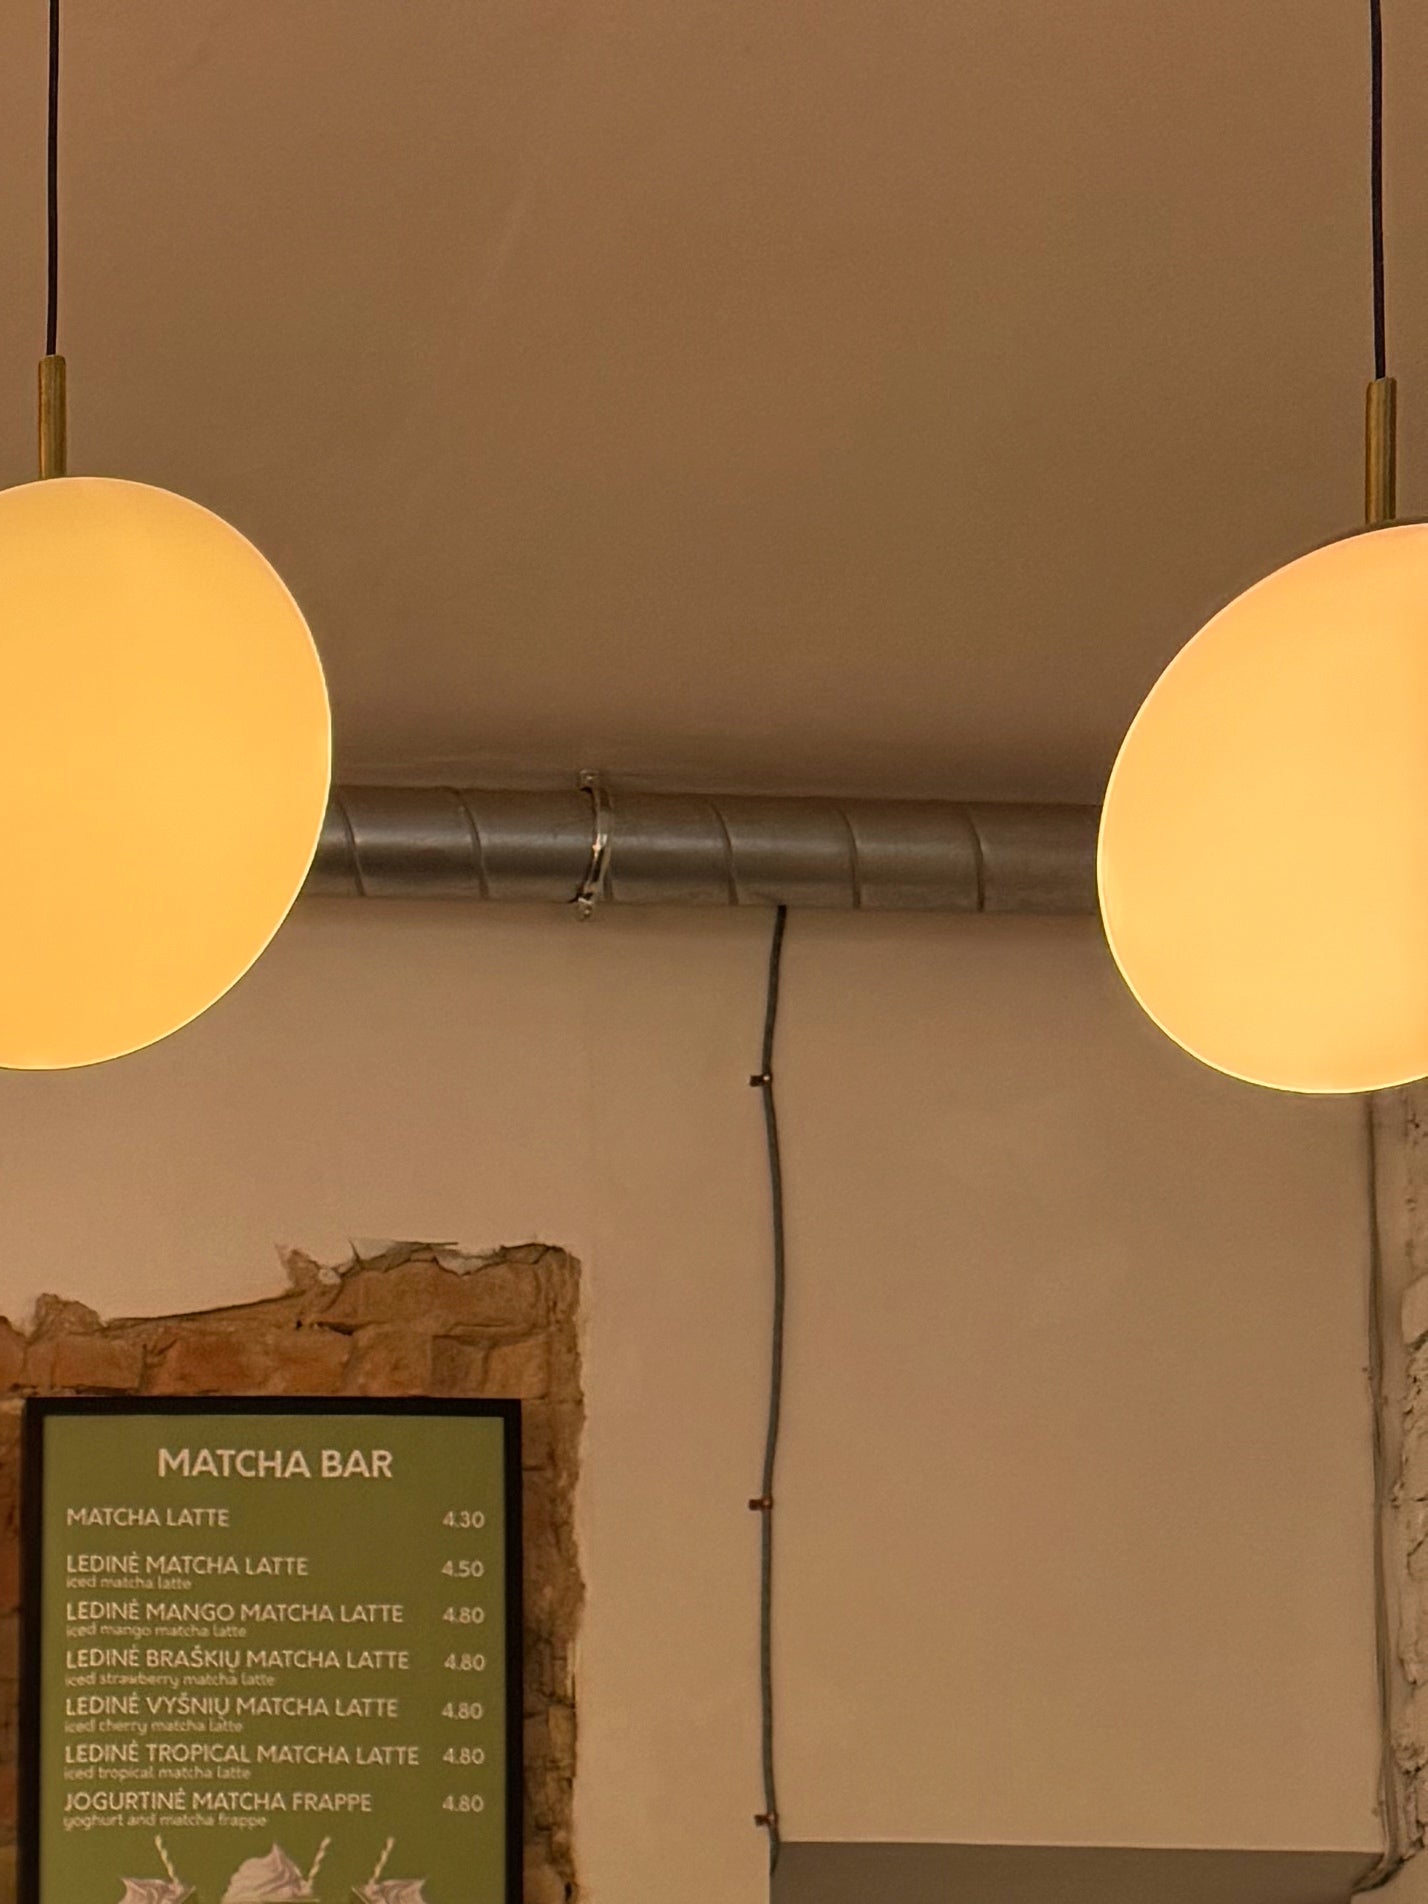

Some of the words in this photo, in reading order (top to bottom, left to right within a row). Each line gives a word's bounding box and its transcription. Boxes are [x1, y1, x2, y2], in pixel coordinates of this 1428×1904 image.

[158, 1448, 311, 1478] MATCHA
[320, 1449, 393, 1479] BAR
[66, 1508, 161, 1527] MATCHA
[166, 1508, 230, 1528] LATTE
[442, 1511, 485, 1529] 4.30
[66, 1551, 140, 1574] LEDINĖ
[145, 1556, 241, 1576] MATCHA
[245, 1557, 309, 1576] LATTE
[441, 1561, 484, 1578] 4.50
[66, 1576, 97, 1590] iced
[100, 1576, 154, 1590] matcha
[158, 1576, 191, 1590] latte
[66, 1598, 140, 1621] LEDINĖ
[145, 1603, 235, 1622] MANGO
[240, 1604, 334, 1623] MATCHA
[340, 1605, 403, 1624] LATTE
[442, 1607, 485, 1625] 4.80
[66, 1624, 97, 1638] iced
[100, 1627, 152, 1641] mango
[155, 1624, 210, 1638] matcha
[213, 1625, 247, 1638] latte
[66, 1645, 140, 1669] LEDINĖ
[145, 1646, 241, 1673] BRAŠKIŲ
[246, 1651, 340, 1669] MATCHA
[347, 1652, 410, 1670] LATTE
[444, 1654, 485, 1672] 4.80
[183, 1673, 239, 1686] matcha
[241, 1673, 275, 1686] latte
[66, 1692, 139, 1716] LEDINĖ
[145, 1692, 232, 1721] VYŠNIŲ
[237, 1698, 329, 1716] MATCHA
[335, 1699, 398, 1718] LATTE
[441, 1703, 484, 1720] 4.80
[152, 1719, 207, 1733] matcha
[209, 1719, 243, 1733] latte
[66, 1739, 139, 1764] LEDINĖ
[145, 1744, 250, 1764] TROPICAL
[257, 1746, 350, 1764] MATCHA
[356, 1747, 420, 1766] LATTE
[442, 1748, 485, 1766] 4.80
[156, 1767, 214, 1781] matcha
[217, 1767, 252, 1781] latte
[64, 1787, 187, 1812] JOGURTINĖ
[192, 1793, 286, 1812] MATCHA
[292, 1793, 372, 1813] FRAPPE
[442, 1796, 485, 1813] 4.80
[160, 1814, 215, 1827] matcha
